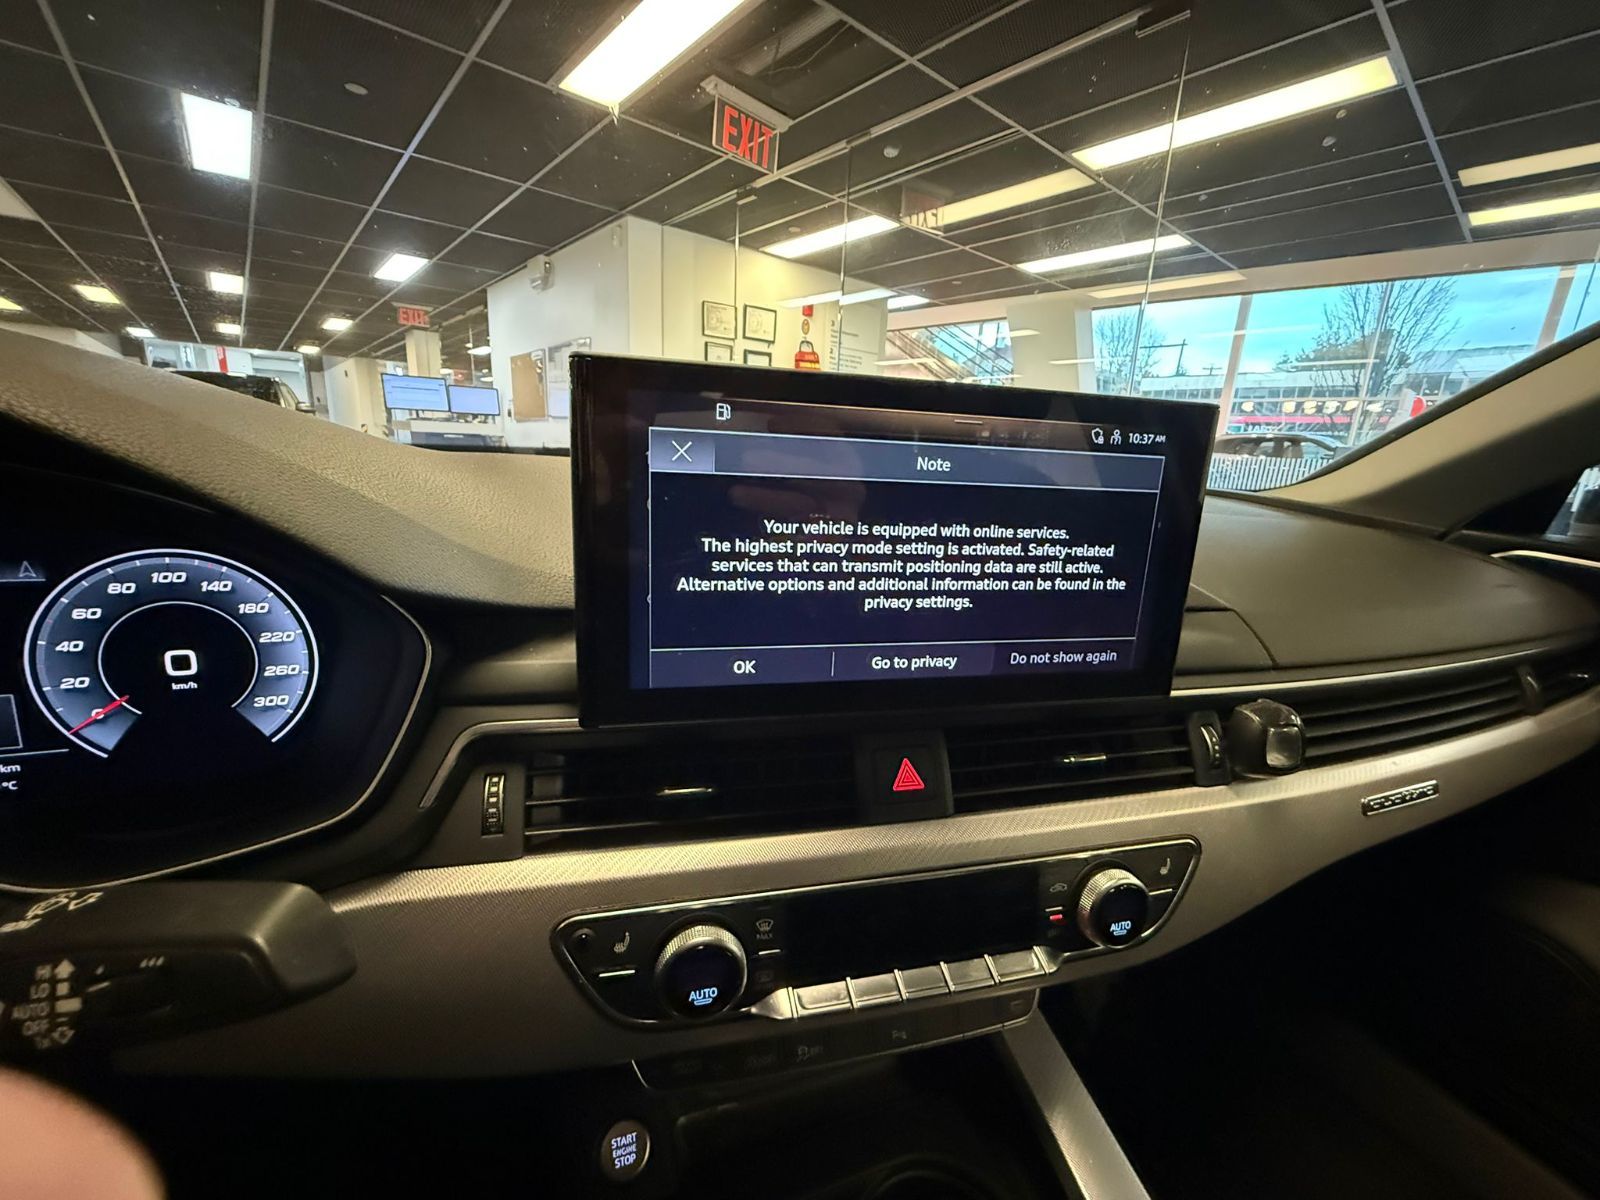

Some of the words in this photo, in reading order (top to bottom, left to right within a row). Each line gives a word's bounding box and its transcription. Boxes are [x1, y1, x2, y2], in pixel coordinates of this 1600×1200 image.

[721, 104, 774, 169] EXIT
[1128, 432, 1155, 444] 10:37
[1155, 434, 1166, 443] AM
[916, 456, 951, 472] Note
[764, 519, 800, 534] Your
[802, 520, 854, 536] vehicle
[857, 521, 869, 536] is
[872, 523, 938, 540] equipped
[940, 524, 970, 538] with
[973, 525, 1014, 538] online
[1016, 526, 1070, 539] services.
[701, 538, 732, 552] The
[735, 538, 794, 556] highest
[796, 540, 849, 557] privacy
[852, 541, 893, 554] mode
[896, 542, 944, 558] setting
[947, 542, 959, 556] is
[961, 543, 1025, 556] activated.
[1027, 543, 1115, 560] Safety-related
[711, 558, 774, 572] services
[776, 558, 810, 572] that
[812, 561, 838, 573] can
[842, 559, 904, 573] transmit
[906, 560, 982, 576] positioning
[984, 560, 1013, 574] data
[1016, 562, 1037, 574] are
[1038, 561, 1063, 574] still
[1065, 562, 1104, 574] active.
[150, 571, 188, 585] 100
[676, 577, 765, 592] Alternative
[768, 578, 826, 594] options
[827, 578, 855, 591] and
[858, 578, 929, 591] additional
[932, 578, 1009, 591] information
[1012, 580, 1034, 590] can
[1036, 578, 1052, 590] be
[1054, 578, 1091, 590] found
[1092, 578, 1104, 590] in
[1106, 578, 1127, 590] the
[106, 581, 137, 596] 80
[200, 579, 233, 594] 140
[238, 602, 270, 616] 180
[864, 596, 913, 612] privacy
[915, 595, 974, 611] settings.
[71, 606, 103, 621] 60
[258, 631, 297, 644] 220
[55, 640, 84, 654] 40
[164, 649, 198, 676] 0
[871, 656, 892, 670] Go
[893, 656, 909, 669] to
[910, 655, 958, 672] privacy
[1010, 652, 1028, 664] Do
[1030, 652, 1051, 664] not
[1052, 651, 1084, 663] show
[1086, 650, 1118, 665] again
[264, 664, 301, 678] 260
[732, 660, 757, 674] OK
[60, 676, 91, 690] 20
[171, 681, 198, 690] km/h
[253, 694, 290, 708] 300
[0, 764, 21, 773] km
[2, 780, 19, 790] °C
[1109, 920, 1132, 932] AUTO
[688, 986, 718, 1002] AUTO
[611, 1131, 638, 1150] START
[612, 1143, 638, 1158] ENGINE
[614, 1152, 637, 1169] STOP
